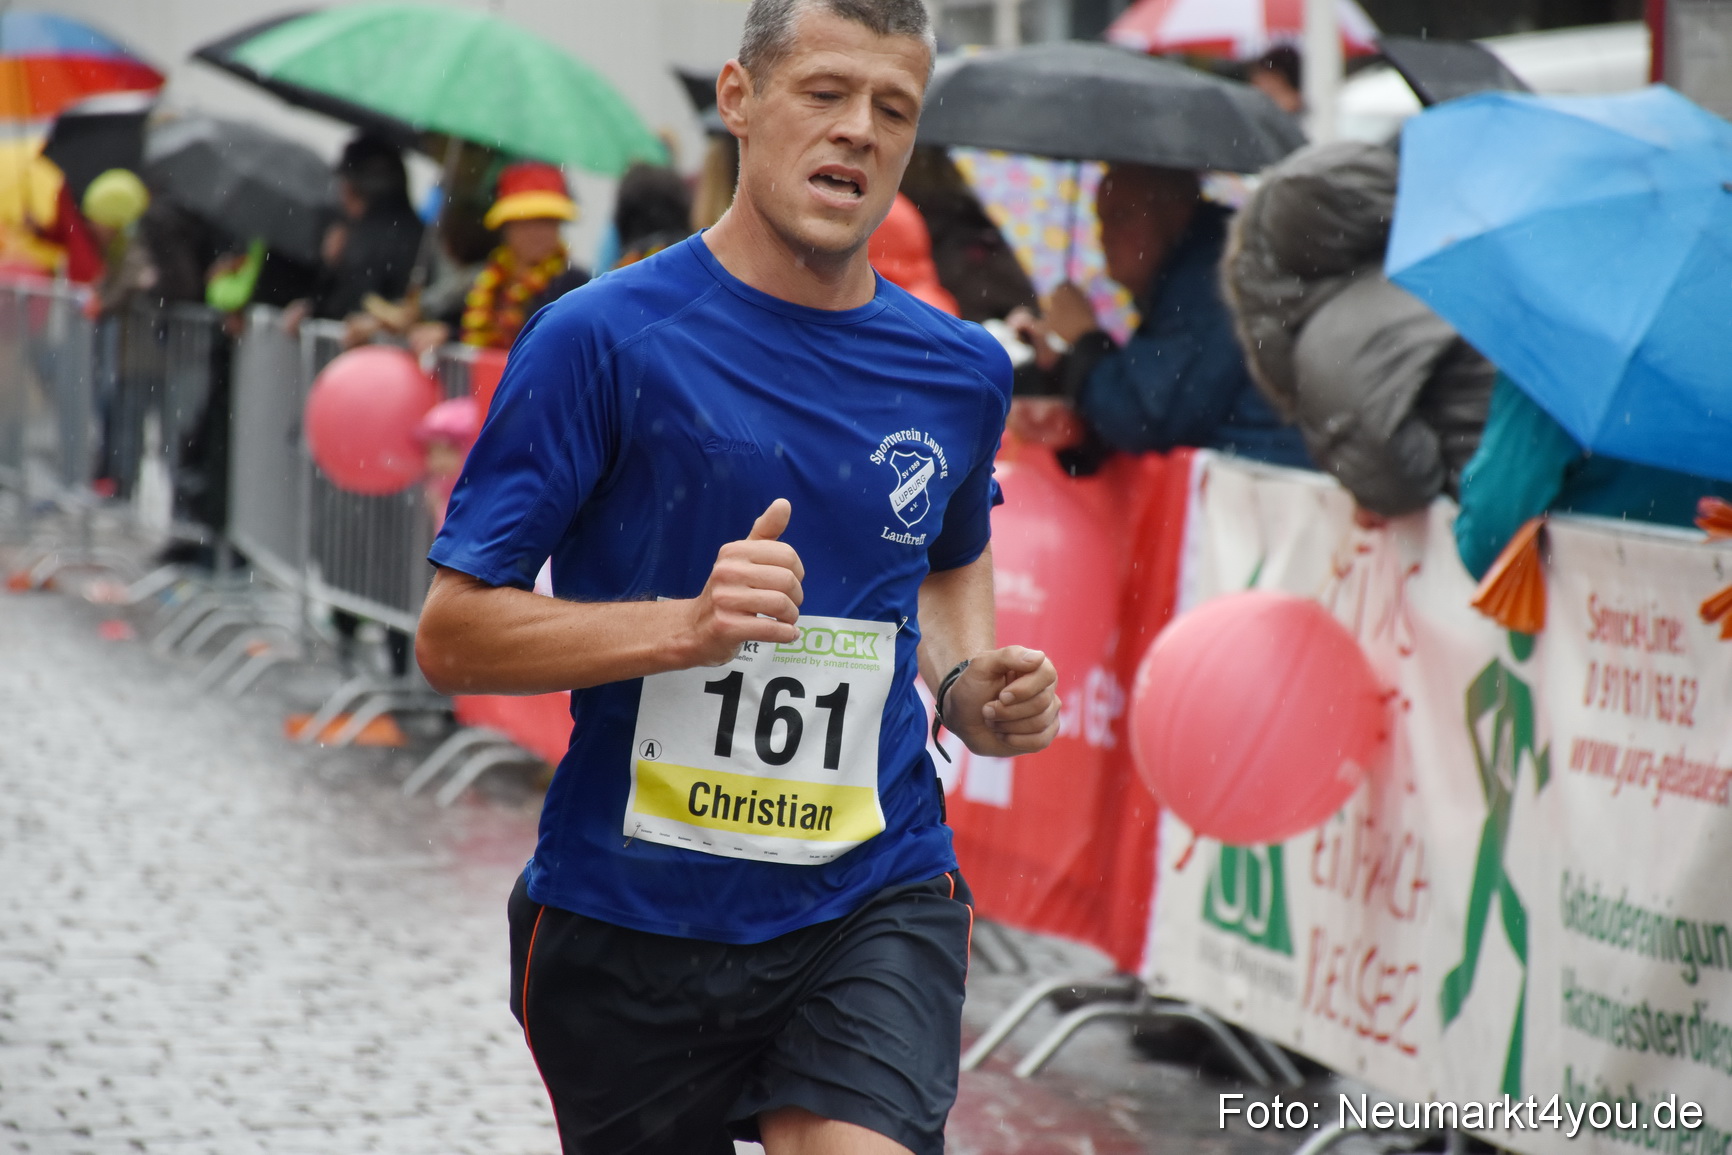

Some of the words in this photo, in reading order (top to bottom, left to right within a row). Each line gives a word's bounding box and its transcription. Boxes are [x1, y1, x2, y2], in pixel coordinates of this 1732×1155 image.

[869, 427, 922, 465] Sportverein
[923, 431, 948, 480] Lupburg
[893, 474, 927, 508] LUPBURG
[901, 469, 910, 480] SV
[880, 526, 927, 545] Lauftreff
[775, 627, 879, 660] BOCK
[772, 655, 807, 665] inspired
[810, 657, 821, 667] by
[823, 659, 849, 669] smart
[850, 661, 880, 672] concepts
[704, 670, 850, 770] 161
[644, 742, 656, 758] A
[688, 780, 833, 832] Christian
